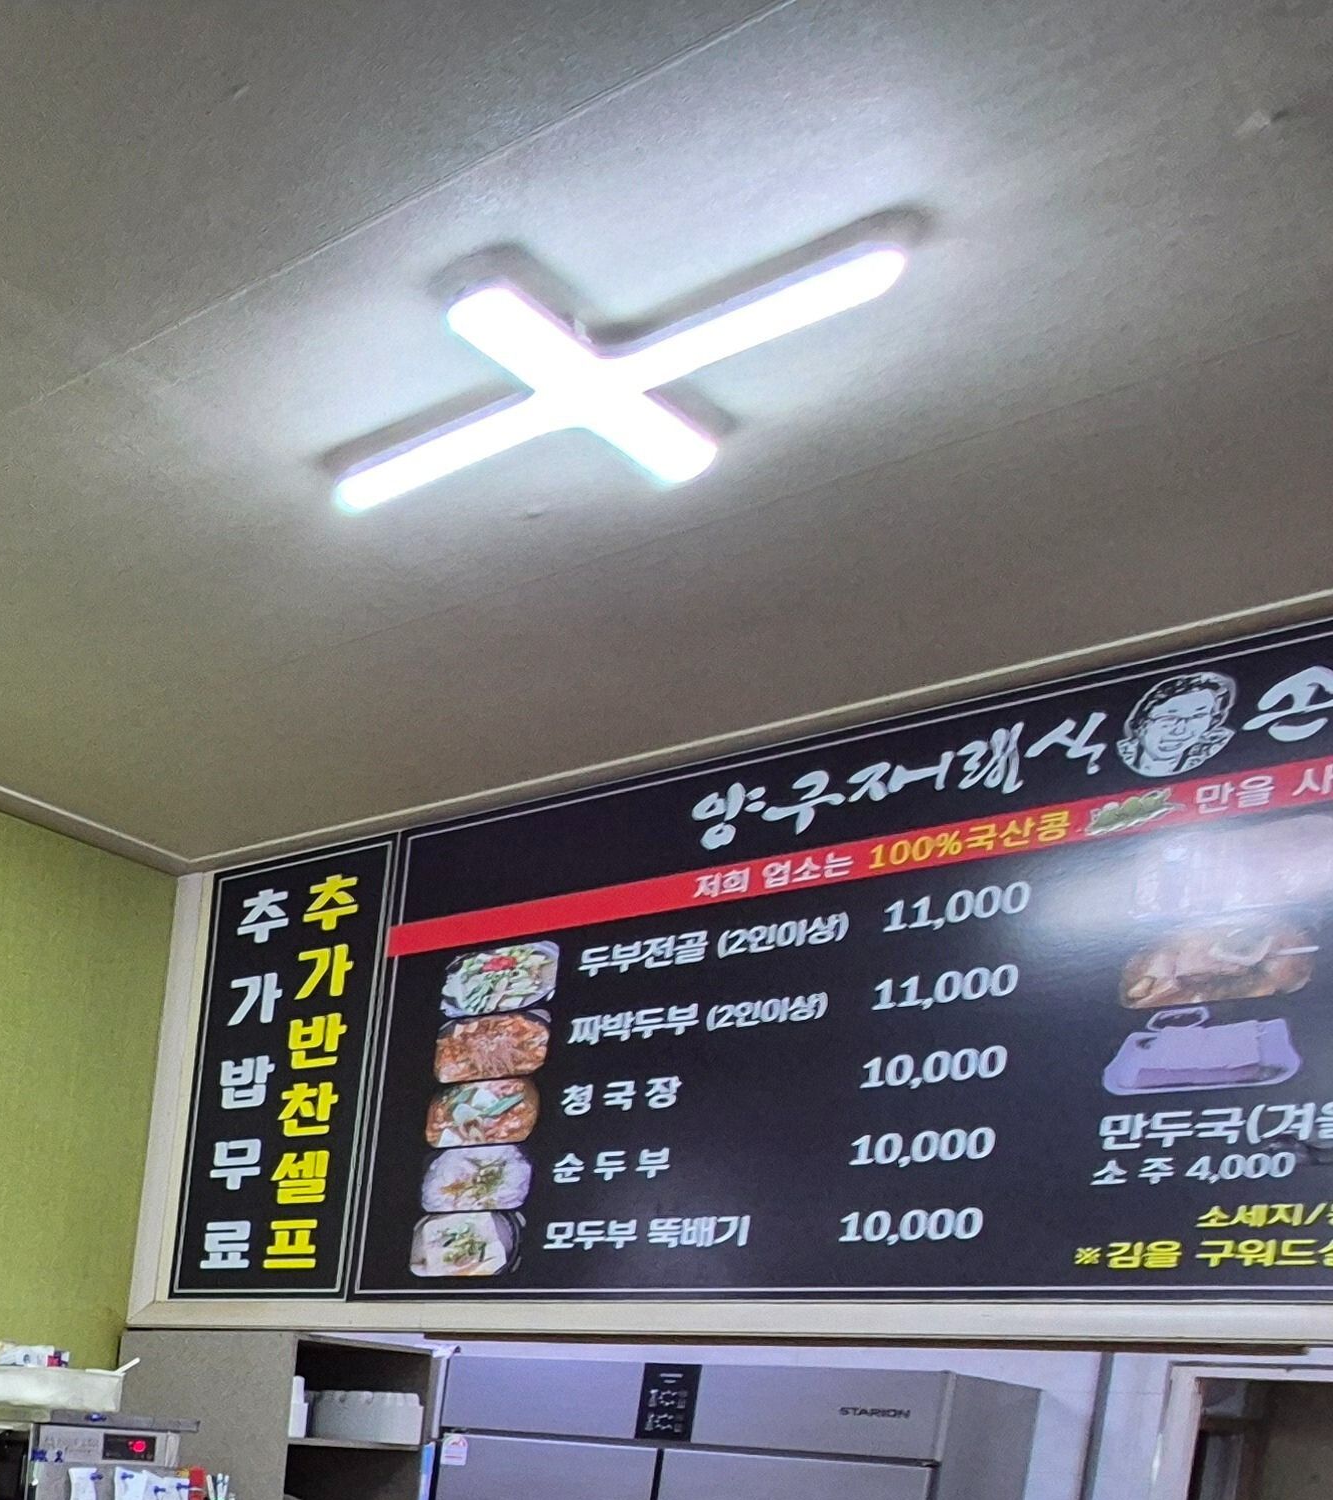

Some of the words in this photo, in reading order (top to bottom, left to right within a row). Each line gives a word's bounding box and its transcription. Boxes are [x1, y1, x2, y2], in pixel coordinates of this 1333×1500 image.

[693, 867, 750, 898] 저희
[762, 853, 853, 890] 업소는
[868, 810, 1070, 870] 100%국산콩
[1196, 775, 1275, 814] 만을
[578, 929, 709, 977] 두부전골
[717, 911, 849, 959] (2인이상)
[882, 881, 1031, 932] 11,000
[567, 1002, 699, 1045] 짜박두부
[706, 992, 829, 1031] (2인이상)
[871, 964, 1019, 1011] 11,000
[859, 1045, 1007, 1089] 10,000
[848, 1127, 995, 1167] 10,000
[1185, 1151, 1297, 1184] 4,000
[543, 1220, 637, 1250] 모두부
[648, 1215, 750, 1247] 뚝배기
[839, 1207, 983, 1245] 10,000
[839, 1407, 910, 1418] STARION
